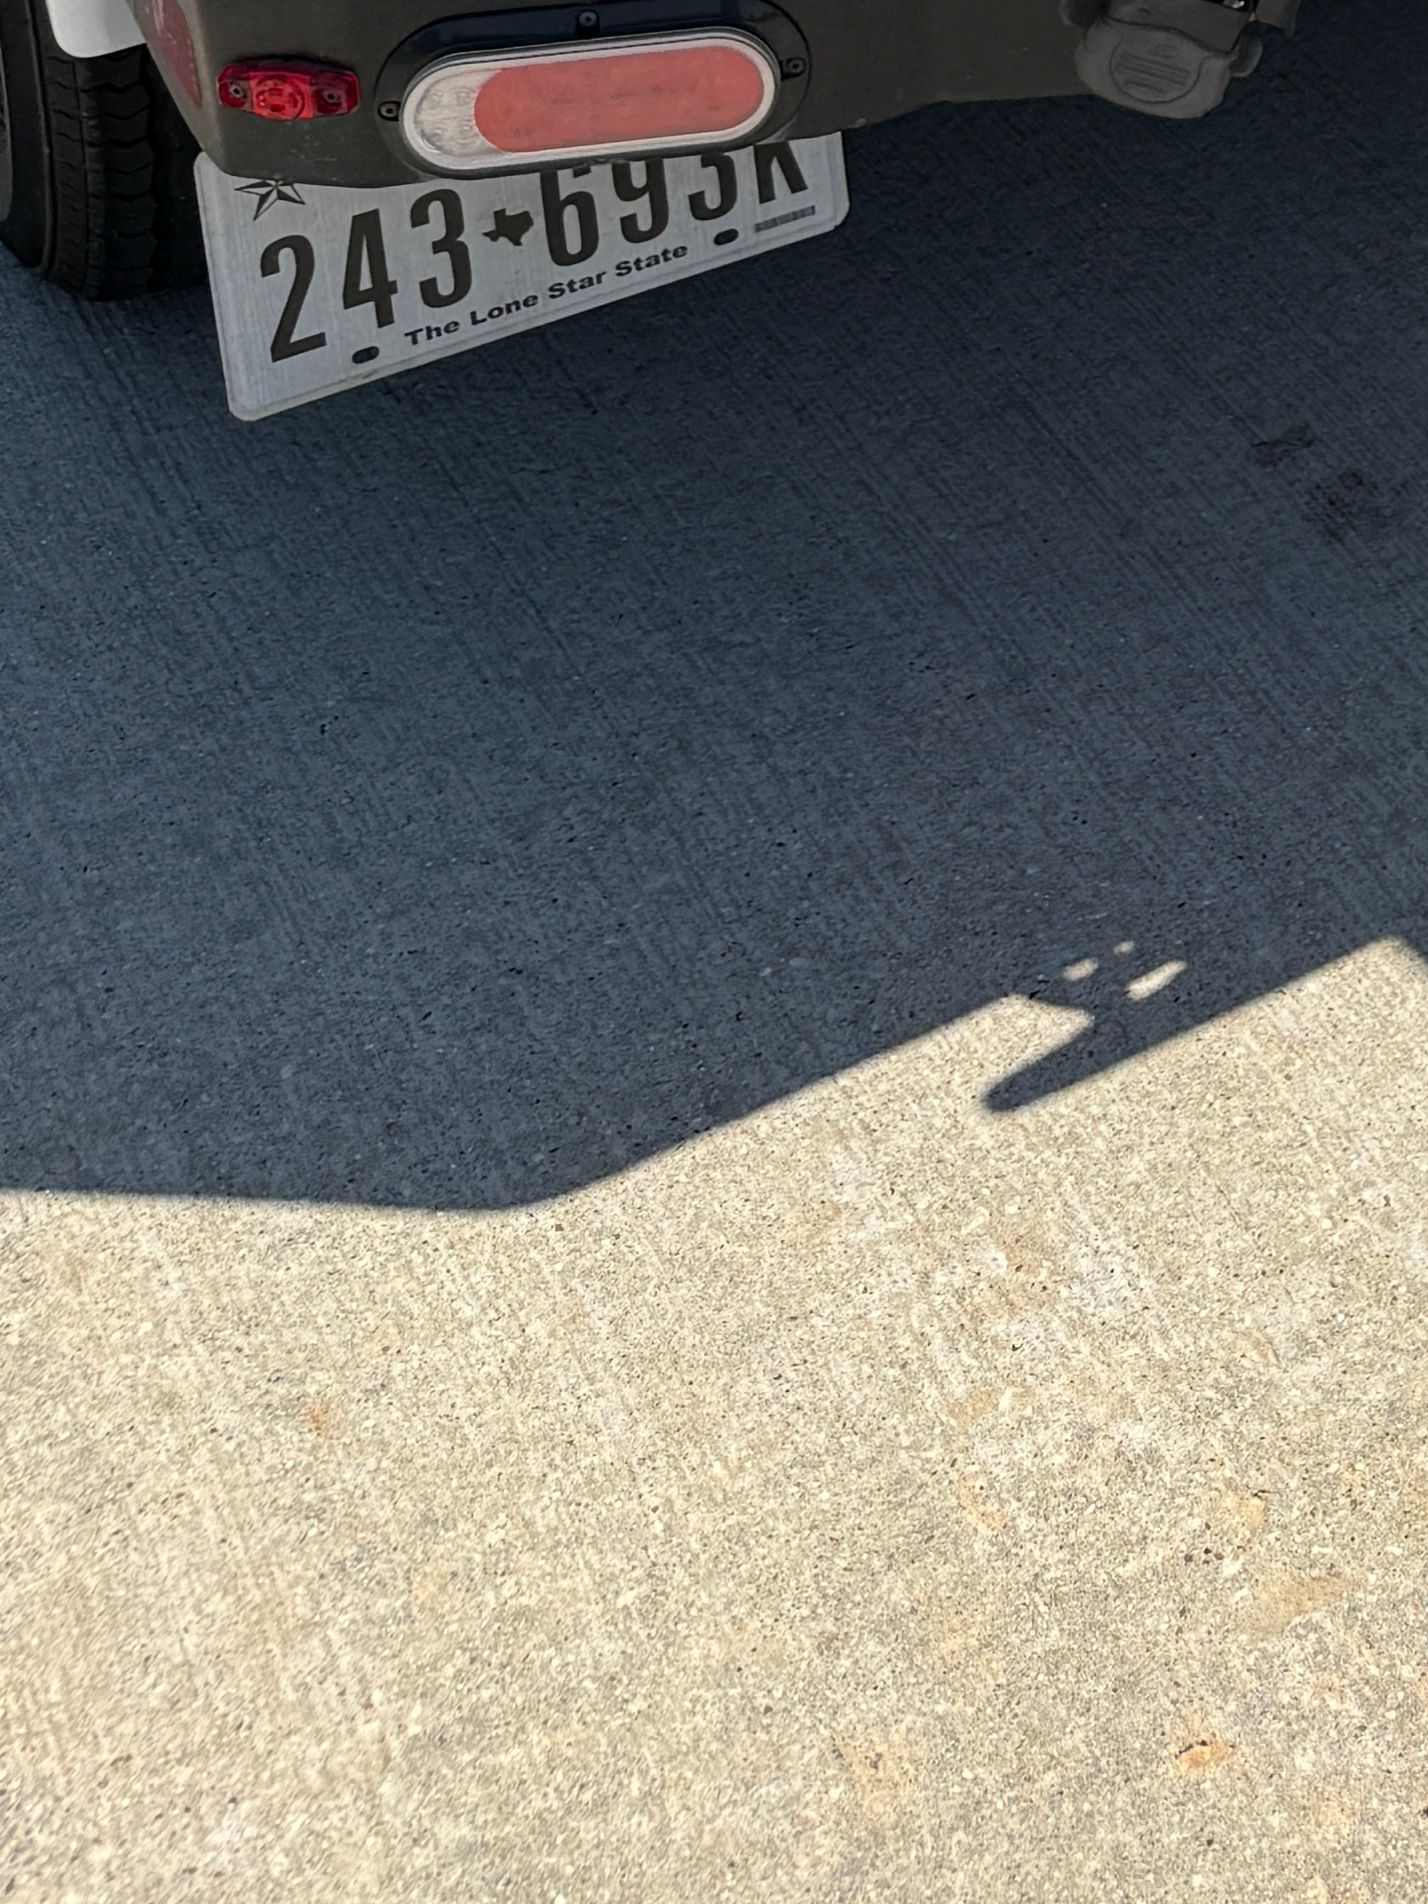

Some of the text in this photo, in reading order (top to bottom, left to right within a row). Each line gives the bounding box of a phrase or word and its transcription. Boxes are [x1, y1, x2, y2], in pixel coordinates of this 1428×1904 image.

[259, 188, 474, 364] 243
[404, 242, 689, 347] The Lone Star State
